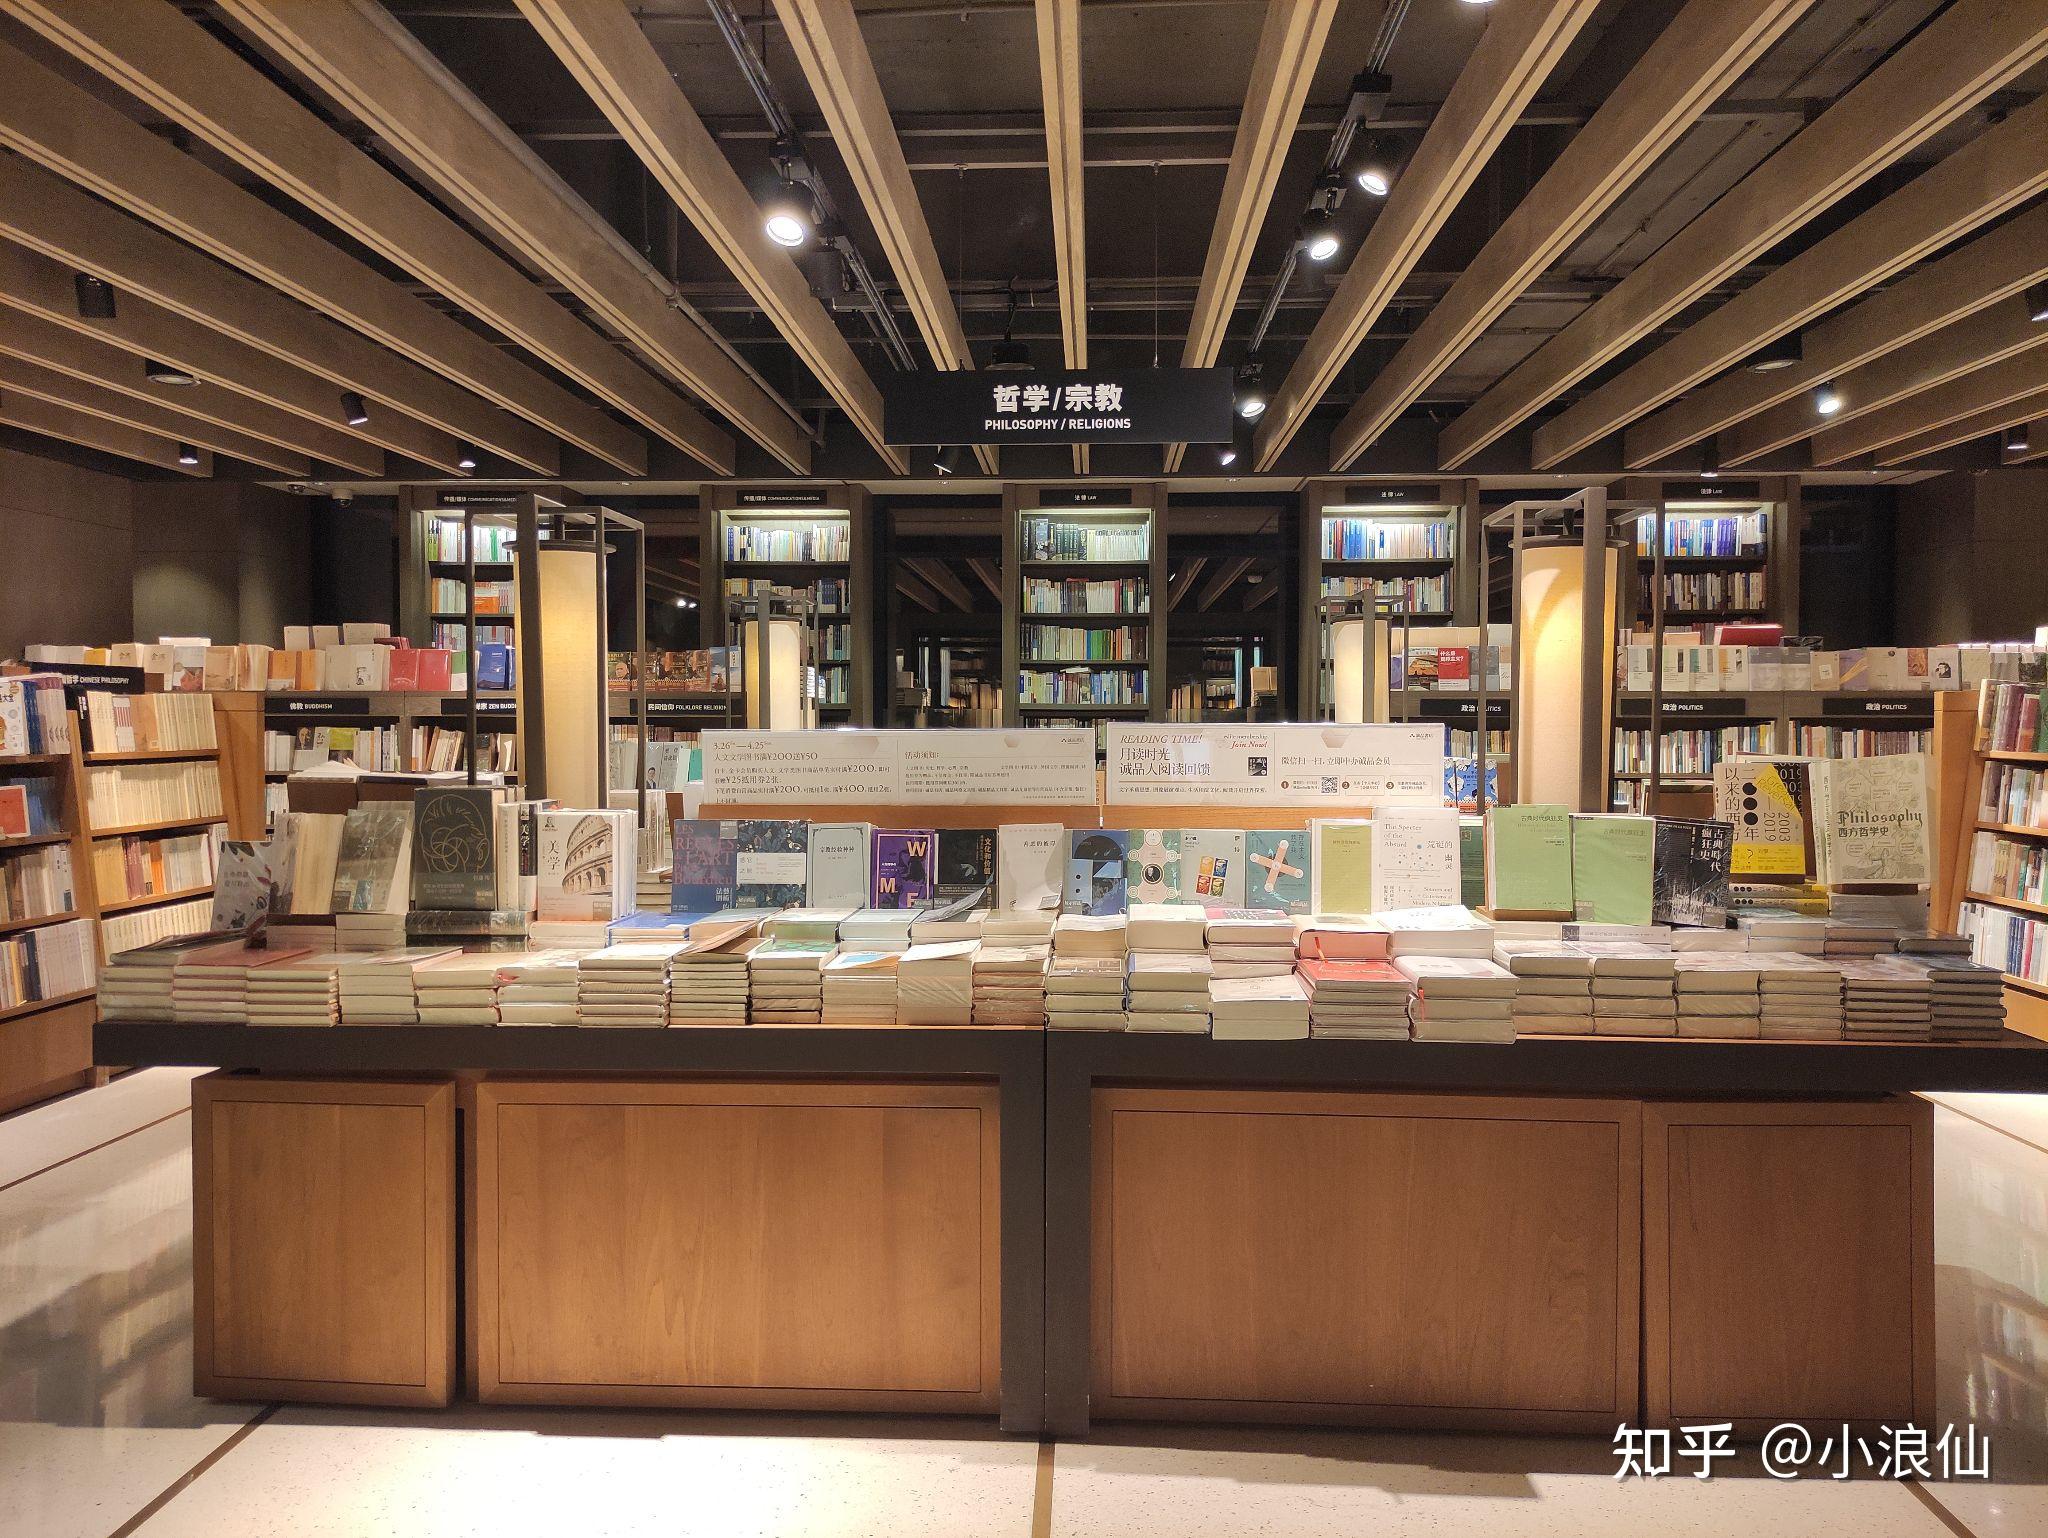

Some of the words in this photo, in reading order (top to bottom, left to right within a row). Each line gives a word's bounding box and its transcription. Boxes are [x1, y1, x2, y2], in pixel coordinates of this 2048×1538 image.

[993, 384, 1123, 412] 哲学/宗教
[985, 418, 1058, 430] PHILOSOPHY
[1060, 418, 1066, 430] /
[1068, 418, 1131, 430] RELIGIONS
[80, 676, 100, 684] CHINESE
[1460, 704, 1476, 712] 政治
[1662, 703, 1677, 711] 政治
[1866, 702, 1880, 710] 政治
[1120, 734, 1168, 744] READING
[1172, 734, 1204, 744] TIME!
[1120, 748, 1170, 761] 月读时光
[1120, 762, 1211, 776] 诚品人阅读回馈
[1838, 808, 1923, 828] Philosophy
[1838, 827, 1889, 838] 西方哲学史
[907, 841, 926, 857] W
[1384, 840, 1407, 848] Absurd
[984, 838, 992, 876] 文化和价值
[880, 878, 896, 894] M
